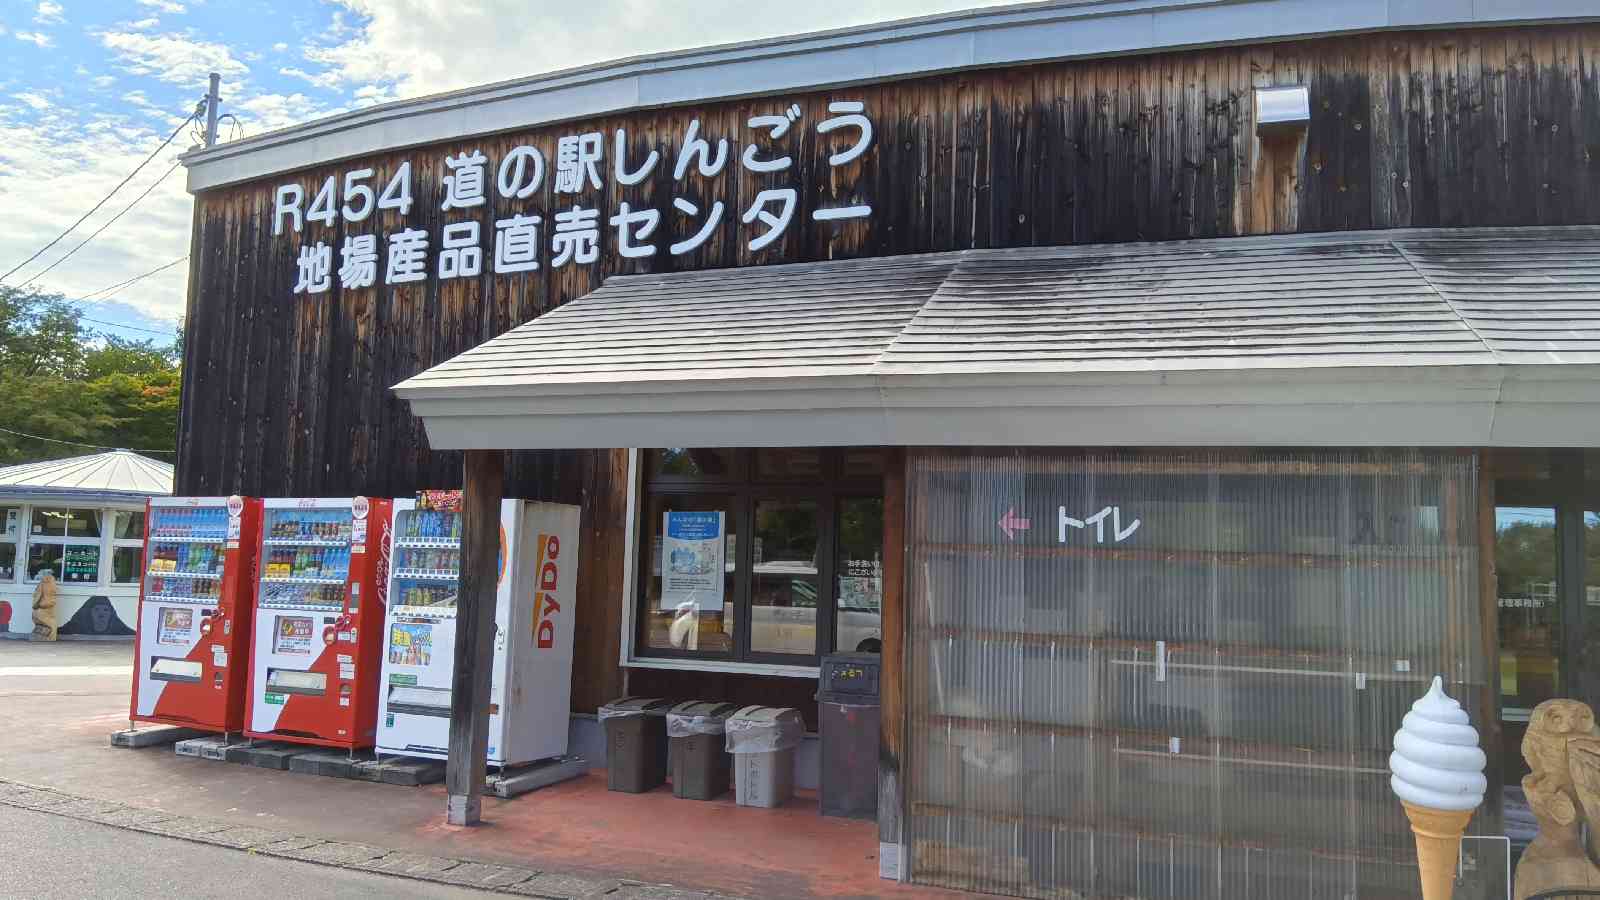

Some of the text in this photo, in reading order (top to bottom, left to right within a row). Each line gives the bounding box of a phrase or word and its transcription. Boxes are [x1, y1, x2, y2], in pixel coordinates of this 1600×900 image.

[273, 100, 873, 237] R454 道の駅しんごう
[292, 187, 873, 295] 地場産品直売センター
[1058, 505, 1141, 543] トイレ
